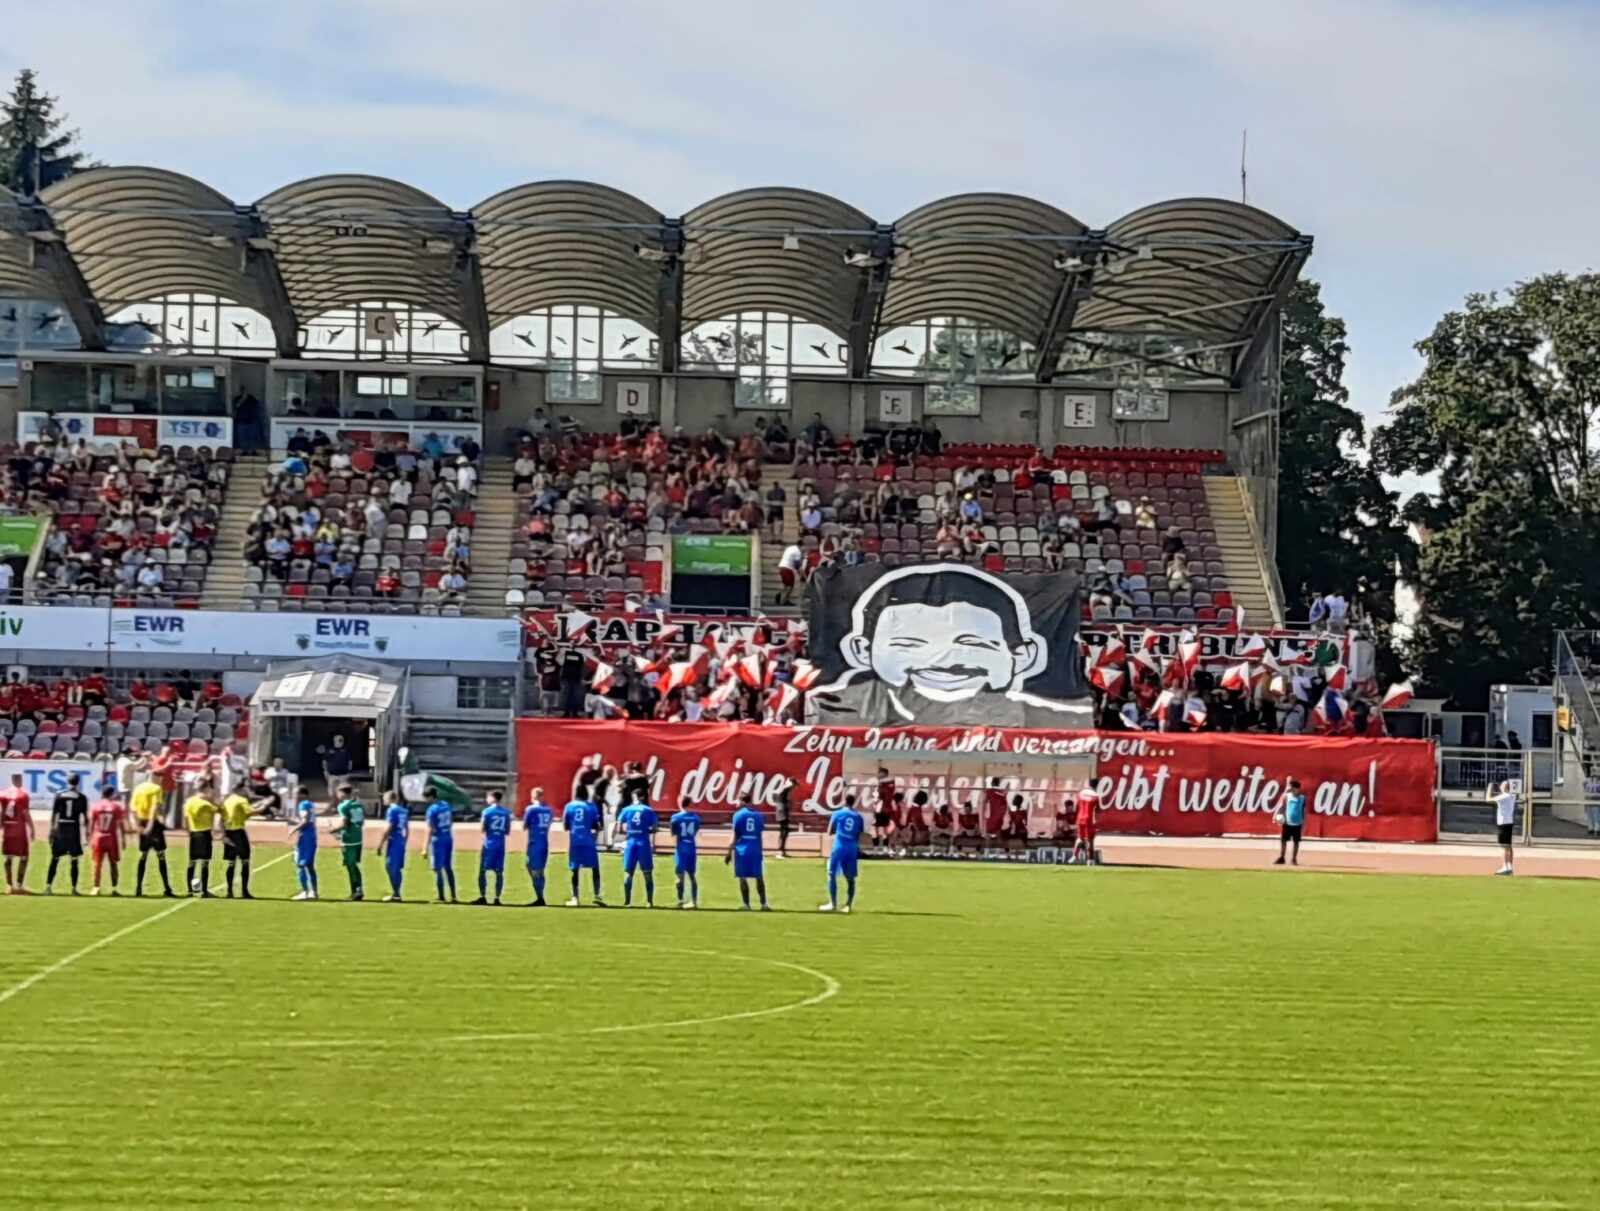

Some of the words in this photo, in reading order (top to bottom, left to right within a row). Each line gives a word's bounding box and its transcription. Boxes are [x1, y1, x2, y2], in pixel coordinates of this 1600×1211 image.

[374, 315, 386, 334] C
[626, 388, 639, 406] D
[1074, 402, 1085, 420] E
[168, 420, 201, 434] TST
[134, 615, 185, 633] EWR
[315, 617, 370, 637] EWR
[783, 726, 853, 754] Zehn
[23, 769, 92, 794] TST
[680, 757, 787, 807] deine
[1178, 765, 1287, 814] weite
[1313, 759, 1377, 818] an!
[489, 815, 508, 830] 21
